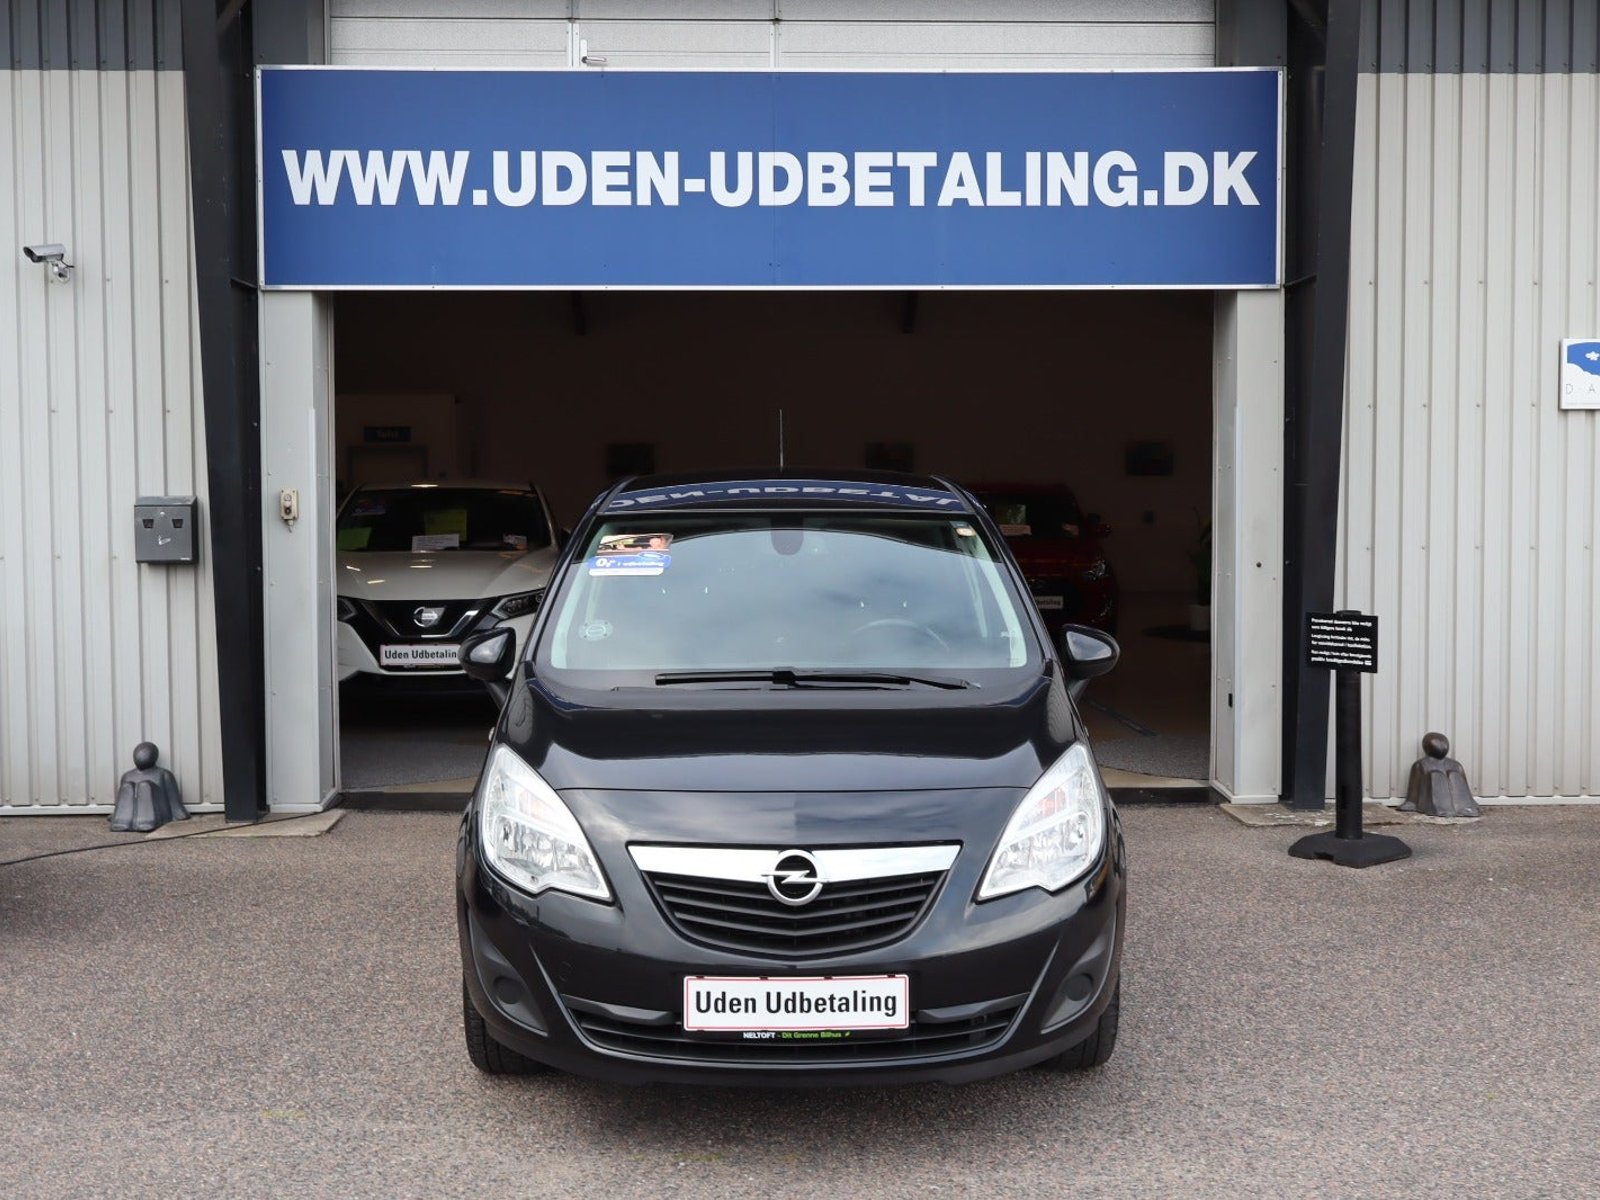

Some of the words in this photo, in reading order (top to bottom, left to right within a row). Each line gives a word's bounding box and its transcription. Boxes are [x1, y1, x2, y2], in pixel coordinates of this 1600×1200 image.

[281, 149, 1261, 207] WWW.UDEN-UDBETALING.DK
[384, 649, 409, 659] Uden
[411, 649, 457, 659] Udbetalin
[695, 990, 757, 1014] Uden
[765, 989, 897, 1017] Udbetaling
